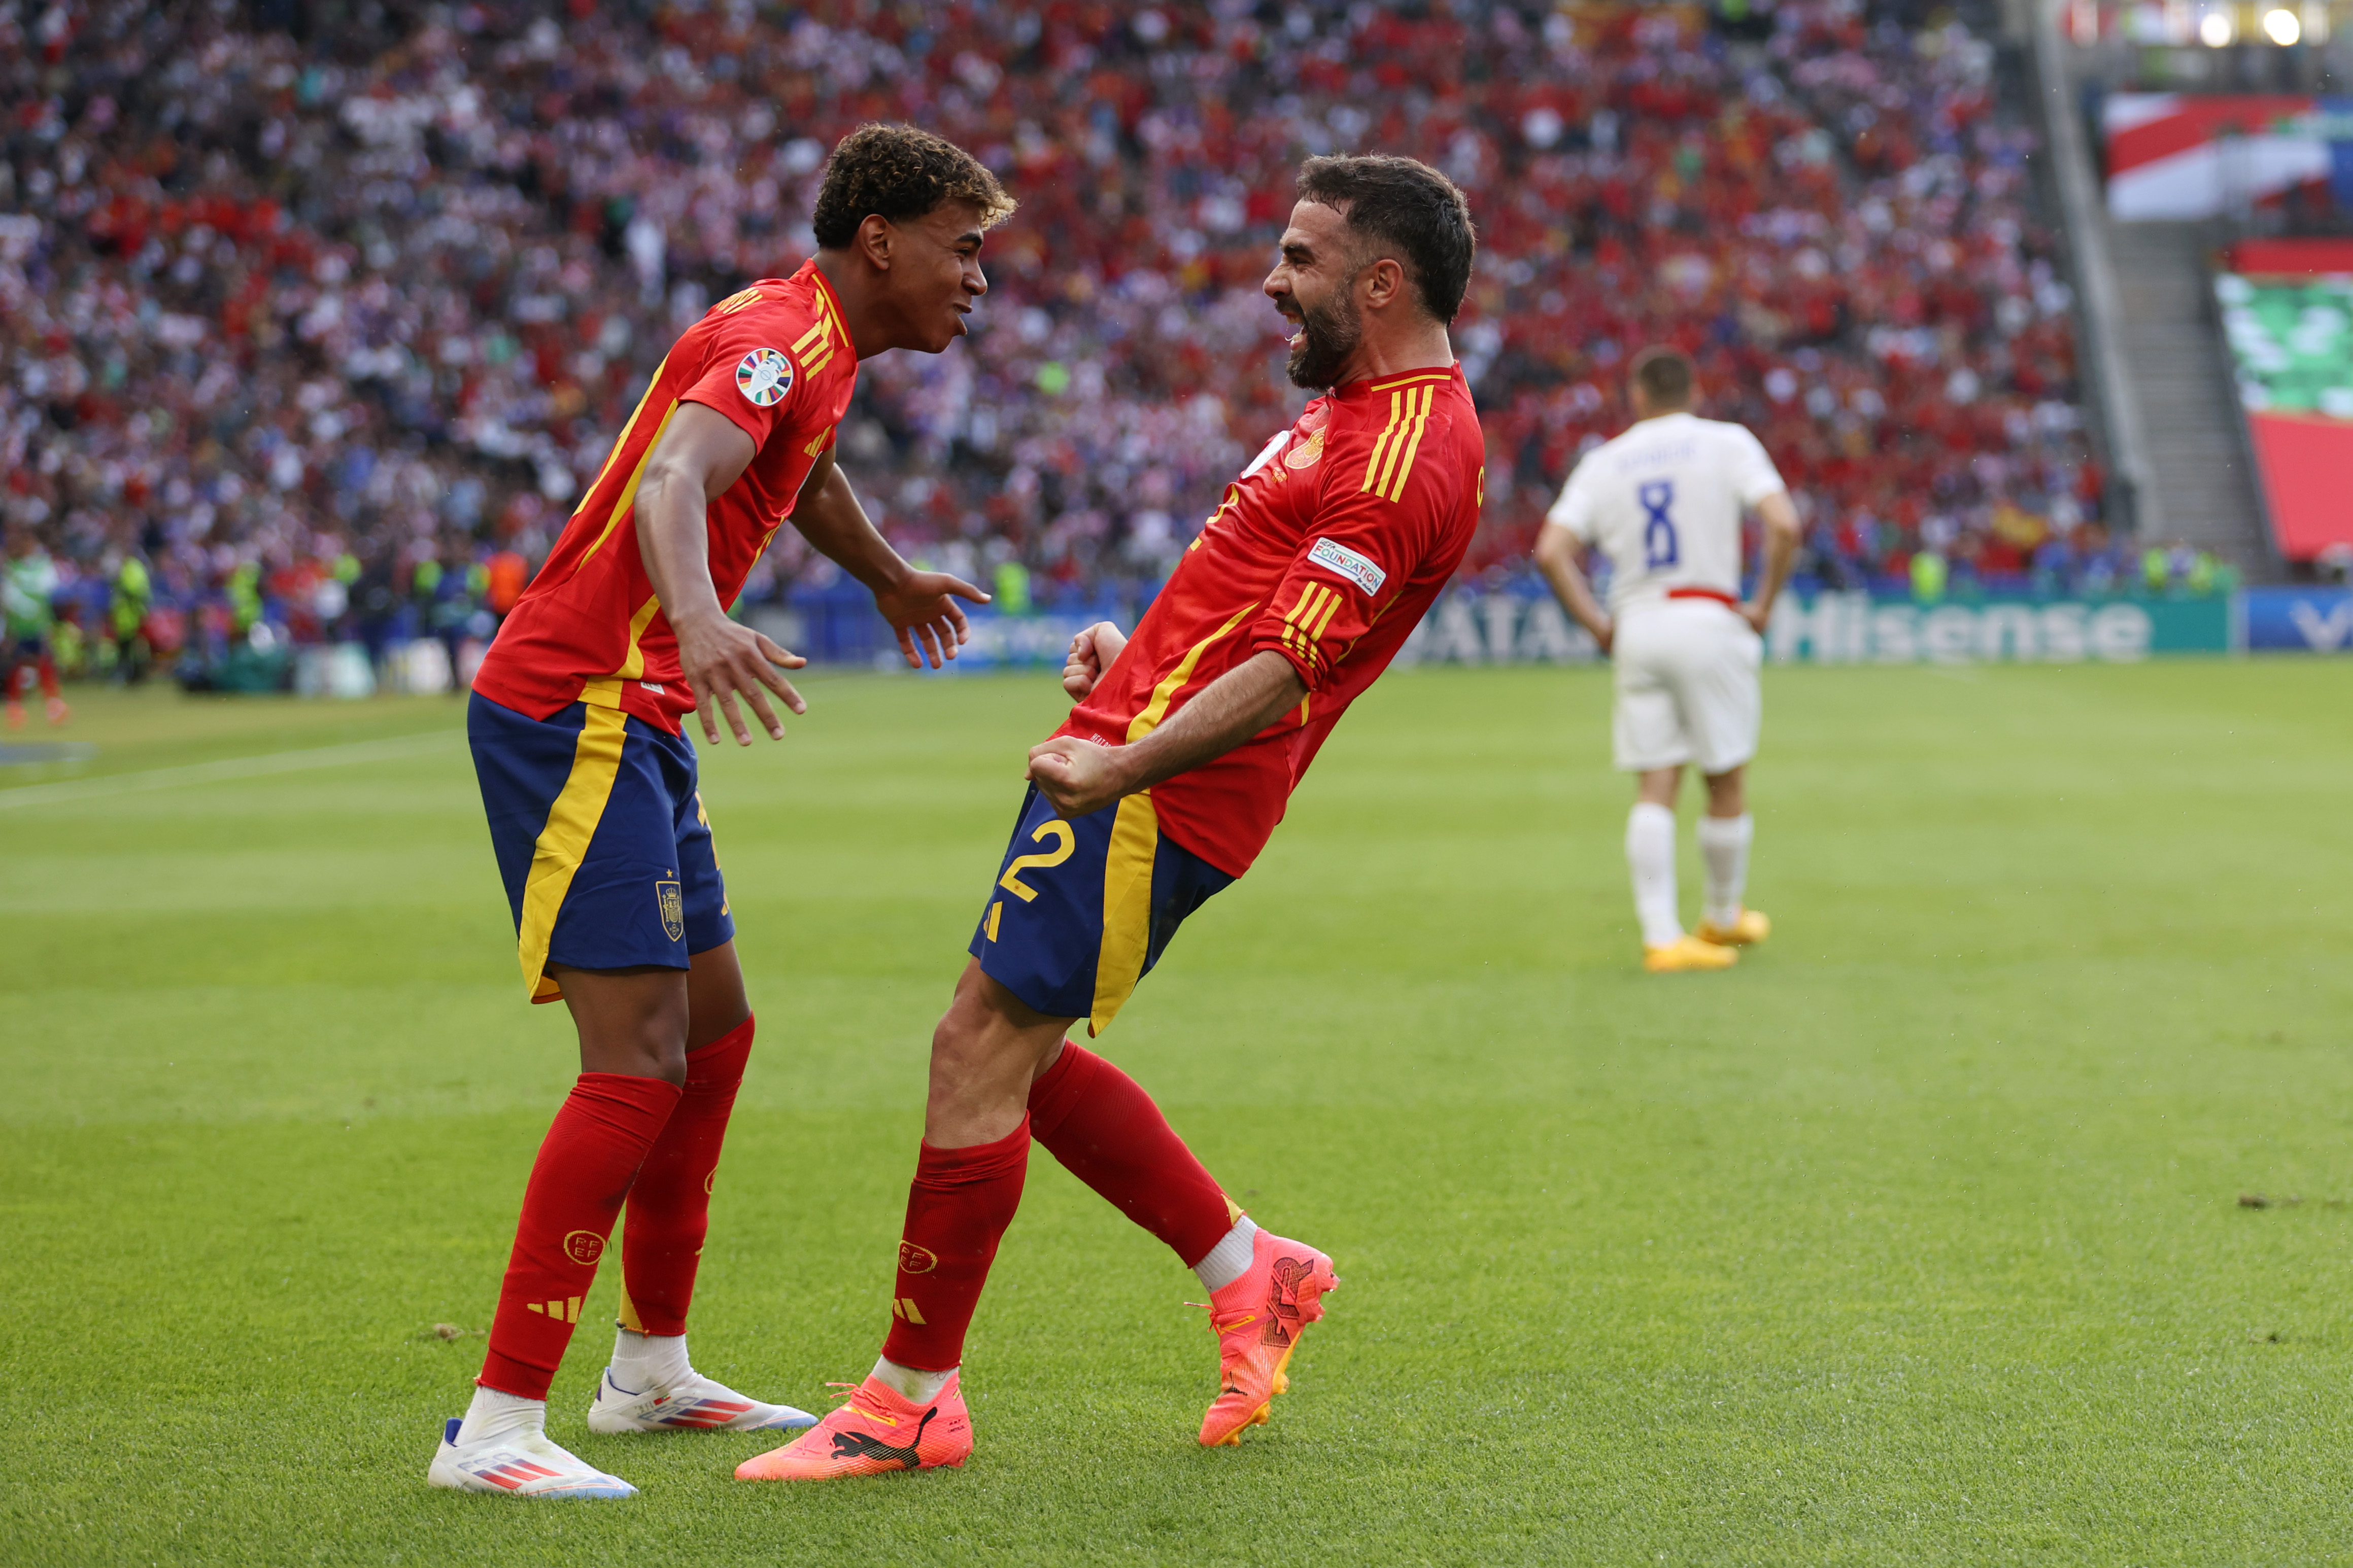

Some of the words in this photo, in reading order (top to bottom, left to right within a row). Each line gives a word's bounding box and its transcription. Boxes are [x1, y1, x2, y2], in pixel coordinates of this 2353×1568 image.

[1319, 539, 1336, 550] UEFA
[1639, 481, 1678, 569] 8
[1314, 545, 1381, 588] FOUNDATION
[1769, 589, 2153, 663] Hisense
[999, 820, 1075, 902] 2
[638, 1396, 699, 1421] F50
[458, 1453, 517, 1472] F50
